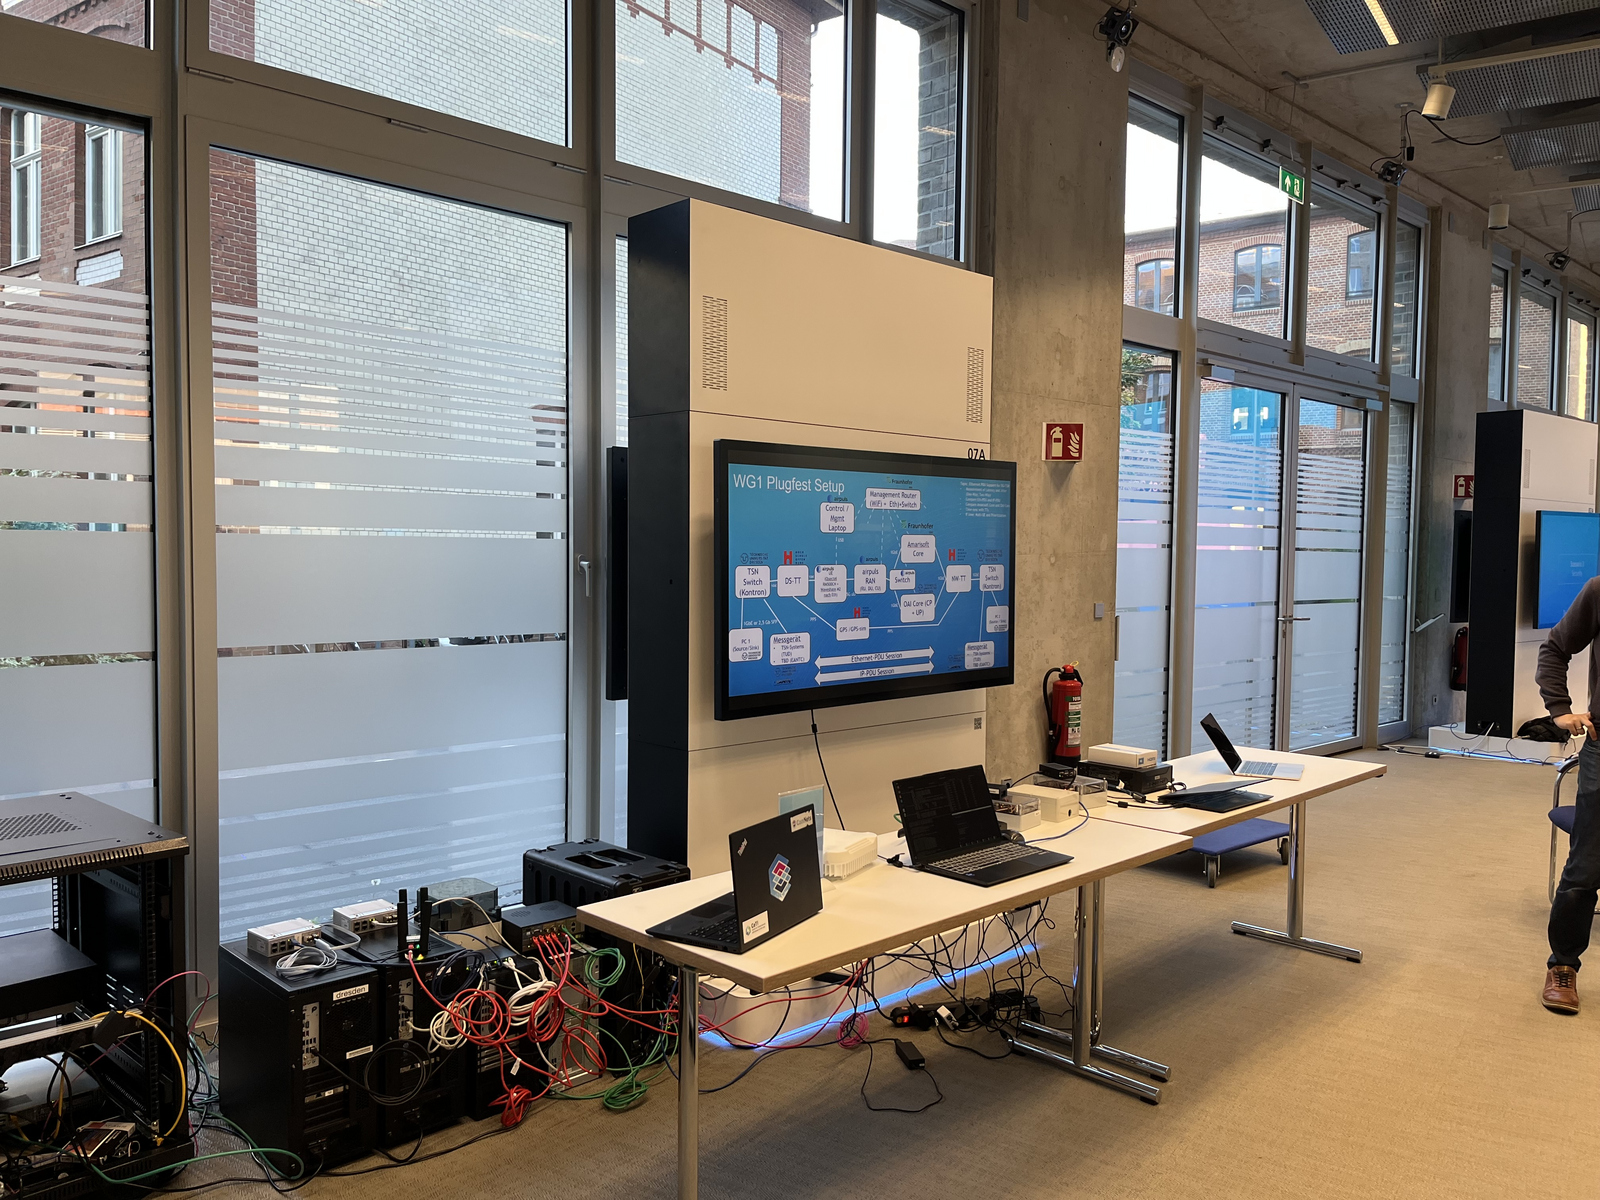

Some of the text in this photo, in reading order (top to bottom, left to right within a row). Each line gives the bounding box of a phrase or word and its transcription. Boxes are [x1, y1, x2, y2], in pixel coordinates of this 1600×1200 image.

[968, 448, 985, 460] 07A
[733, 474, 845, 495] WG1 Plugfest Setup
[869, 491, 900, 499] Management
[825, 504, 845, 512] Control
[830, 515, 845, 523] Mgmt
[828, 524, 847, 533] Laptop
[862, 568, 879, 576] airpuls
[743, 578, 763, 586] Switch
[785, 577, 801, 585] DS-TT
[951, 574, 966, 582] NW-TT
[739, 589, 767, 597] (Kontron)
[773, 635, 801, 644] Messgerät
[851, 653, 885, 662] Ethernet-PDU
[335, 986, 366, 999] dresden
